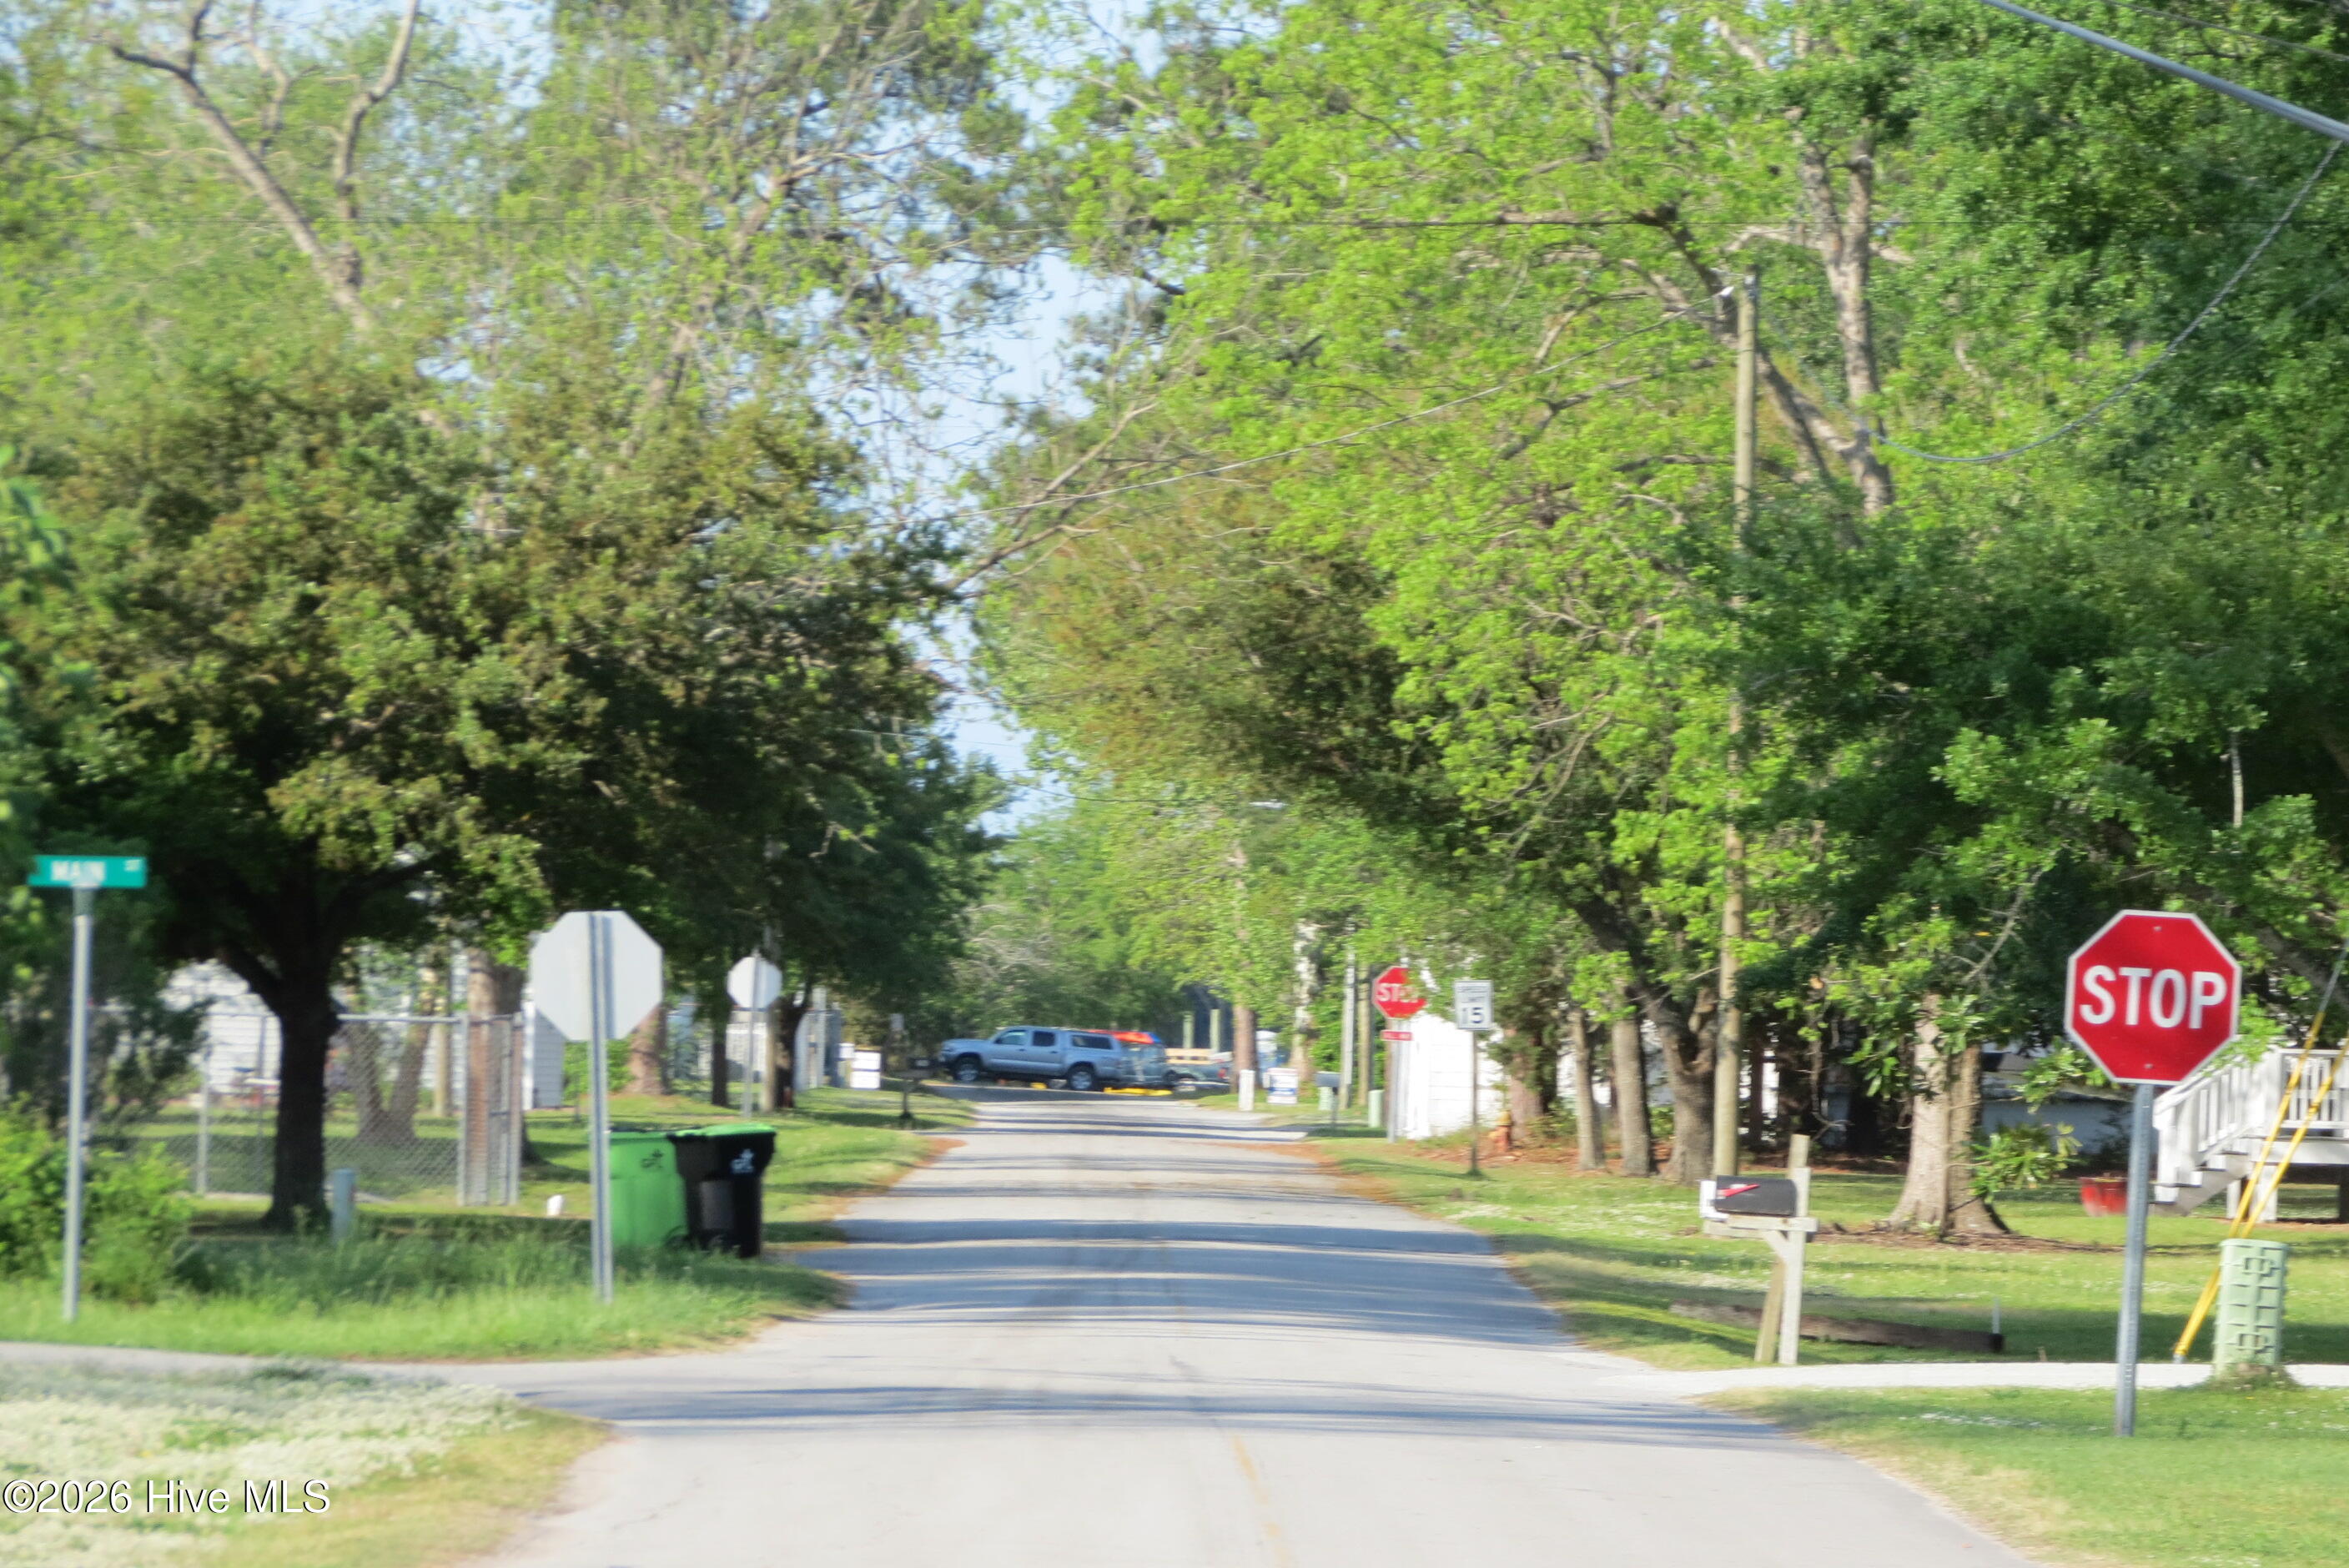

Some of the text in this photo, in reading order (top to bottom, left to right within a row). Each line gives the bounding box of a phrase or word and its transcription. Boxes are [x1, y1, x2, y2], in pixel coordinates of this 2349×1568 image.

[1376, 983, 1419, 1003] STO
[2079, 964, 2228, 1030] STOP
[1461, 1006, 1485, 1024] 15
